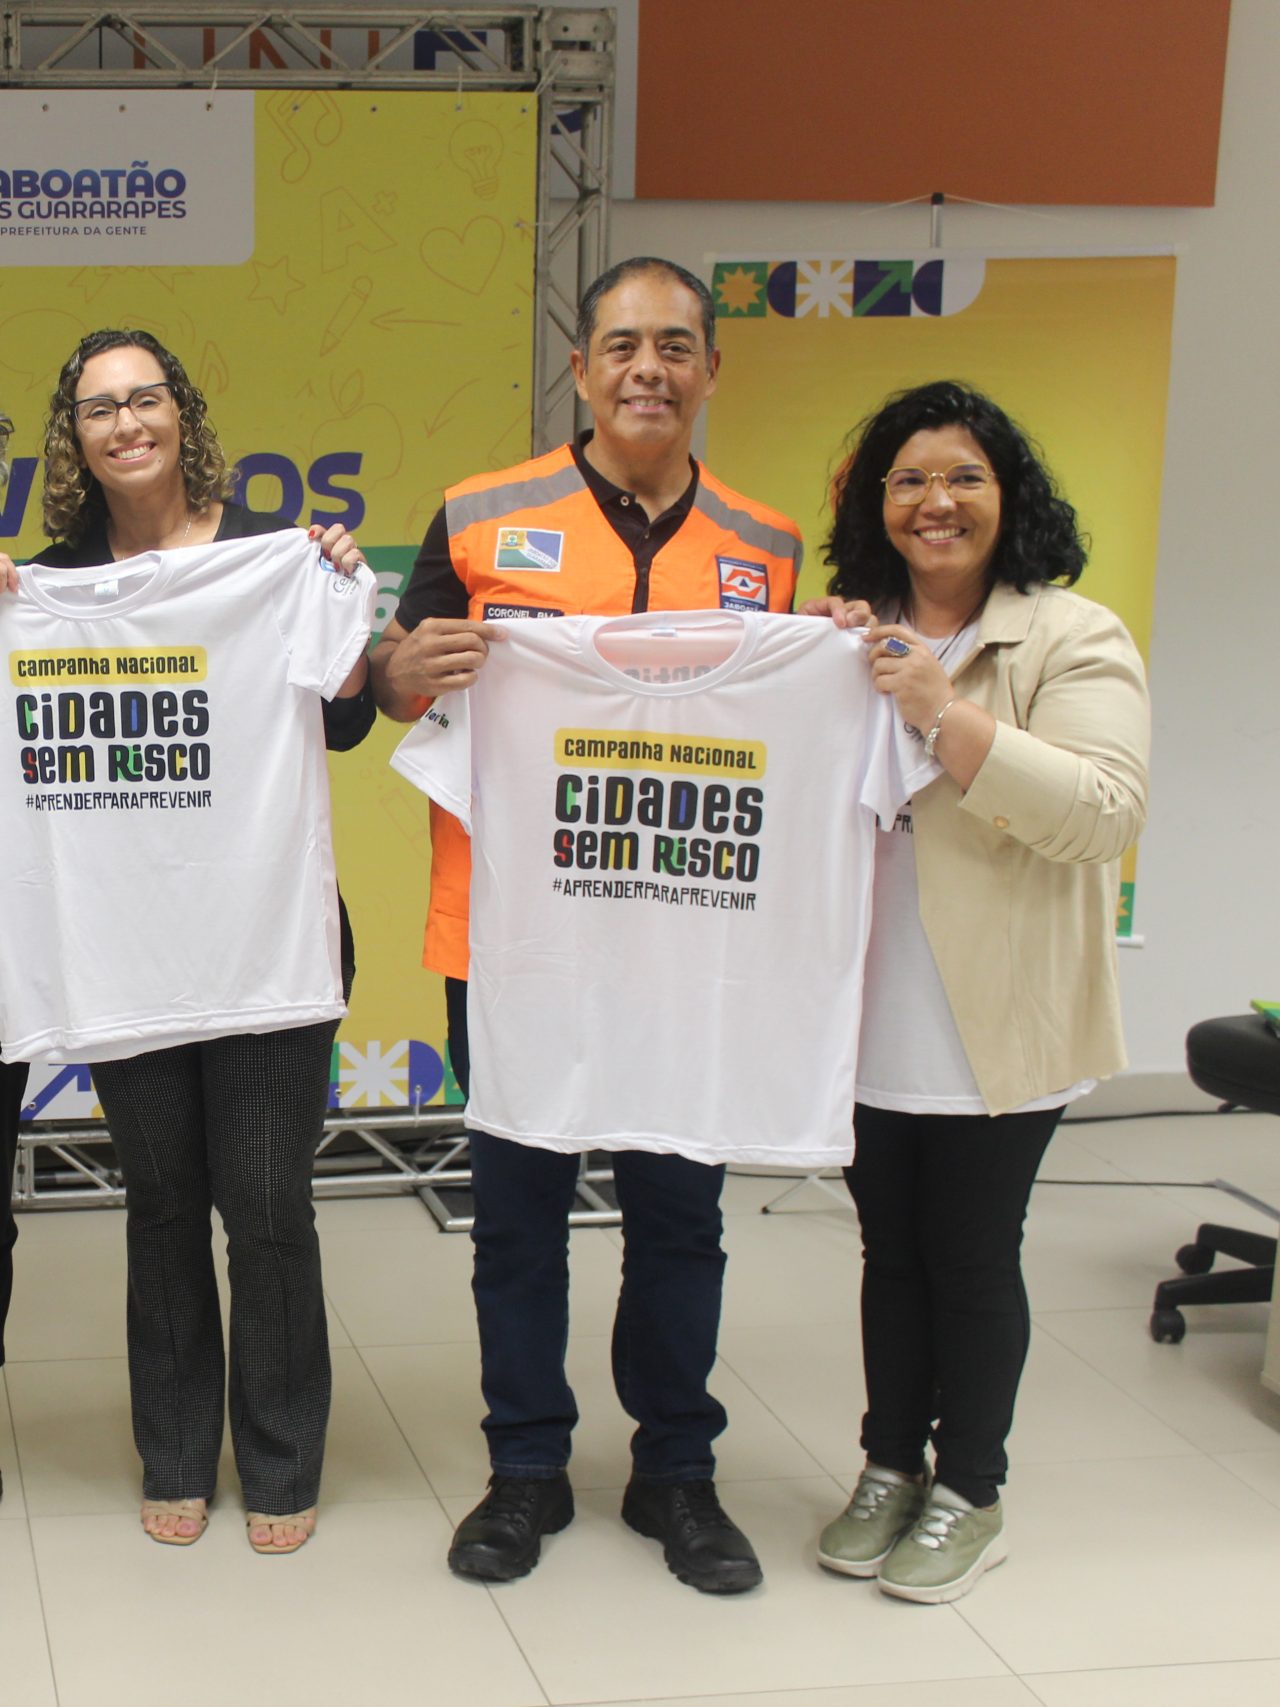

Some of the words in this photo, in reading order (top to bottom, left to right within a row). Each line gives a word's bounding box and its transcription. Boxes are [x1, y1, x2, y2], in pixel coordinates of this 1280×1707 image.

[18, 200, 186, 219] GUARARAPES
[1, 226, 79, 236] PREFEITURA
[84, 226, 101, 235] DA
[106, 225, 147, 235] GENTE
[25, 790, 211, 811] #APRENDERPARAPREVENIR
[552, 877, 757, 911] #APRENDERPARAPREVENIR
